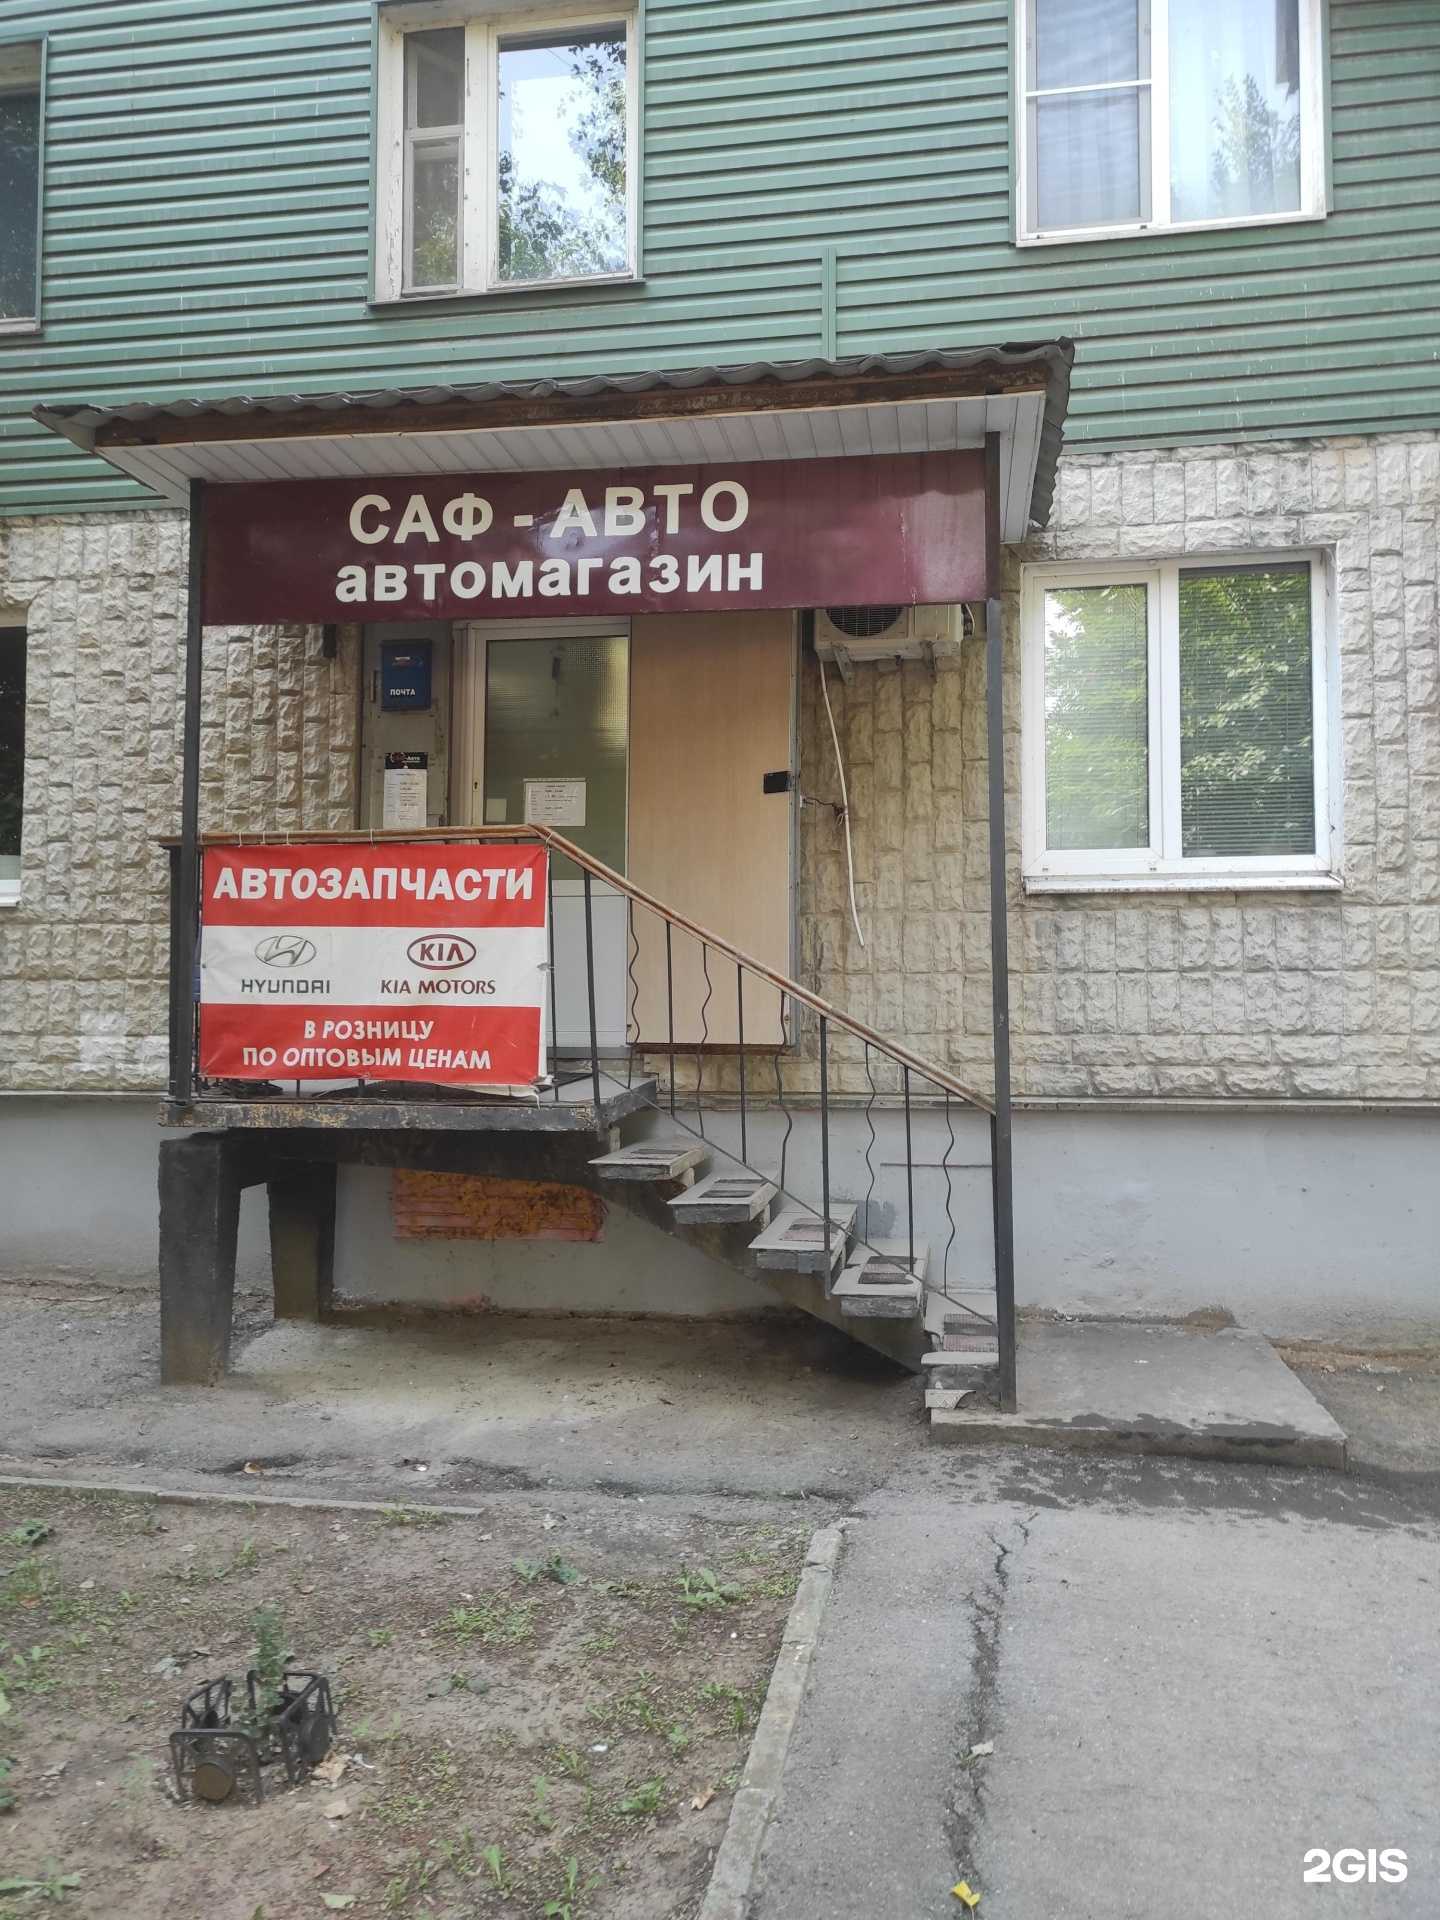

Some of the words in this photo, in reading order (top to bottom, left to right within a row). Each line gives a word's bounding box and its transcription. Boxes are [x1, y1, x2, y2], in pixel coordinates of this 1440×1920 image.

[349, 492, 494, 544] САФ
[549, 480, 750, 538] АВТО
[335, 552, 763, 603] автомагазин
[390, 688, 416, 696] ПОЧТА
[212, 867, 534, 901] АВТОЗАПЧАСТИ
[419, 943, 465, 962] KIA
[240, 979, 331, 994] HYUNDAI
[380, 979, 412, 995] KIA
[418, 979, 496, 995] MOTORS
[303, 1020, 315, 1040] В
[322, 1020, 434, 1043] РОЗНИЦУ
[242, 1047, 277, 1067] ПО
[282, 1047, 401, 1067] ОПТОВЫМ
[407, 1050, 492, 1071] ЦЕНАМ
